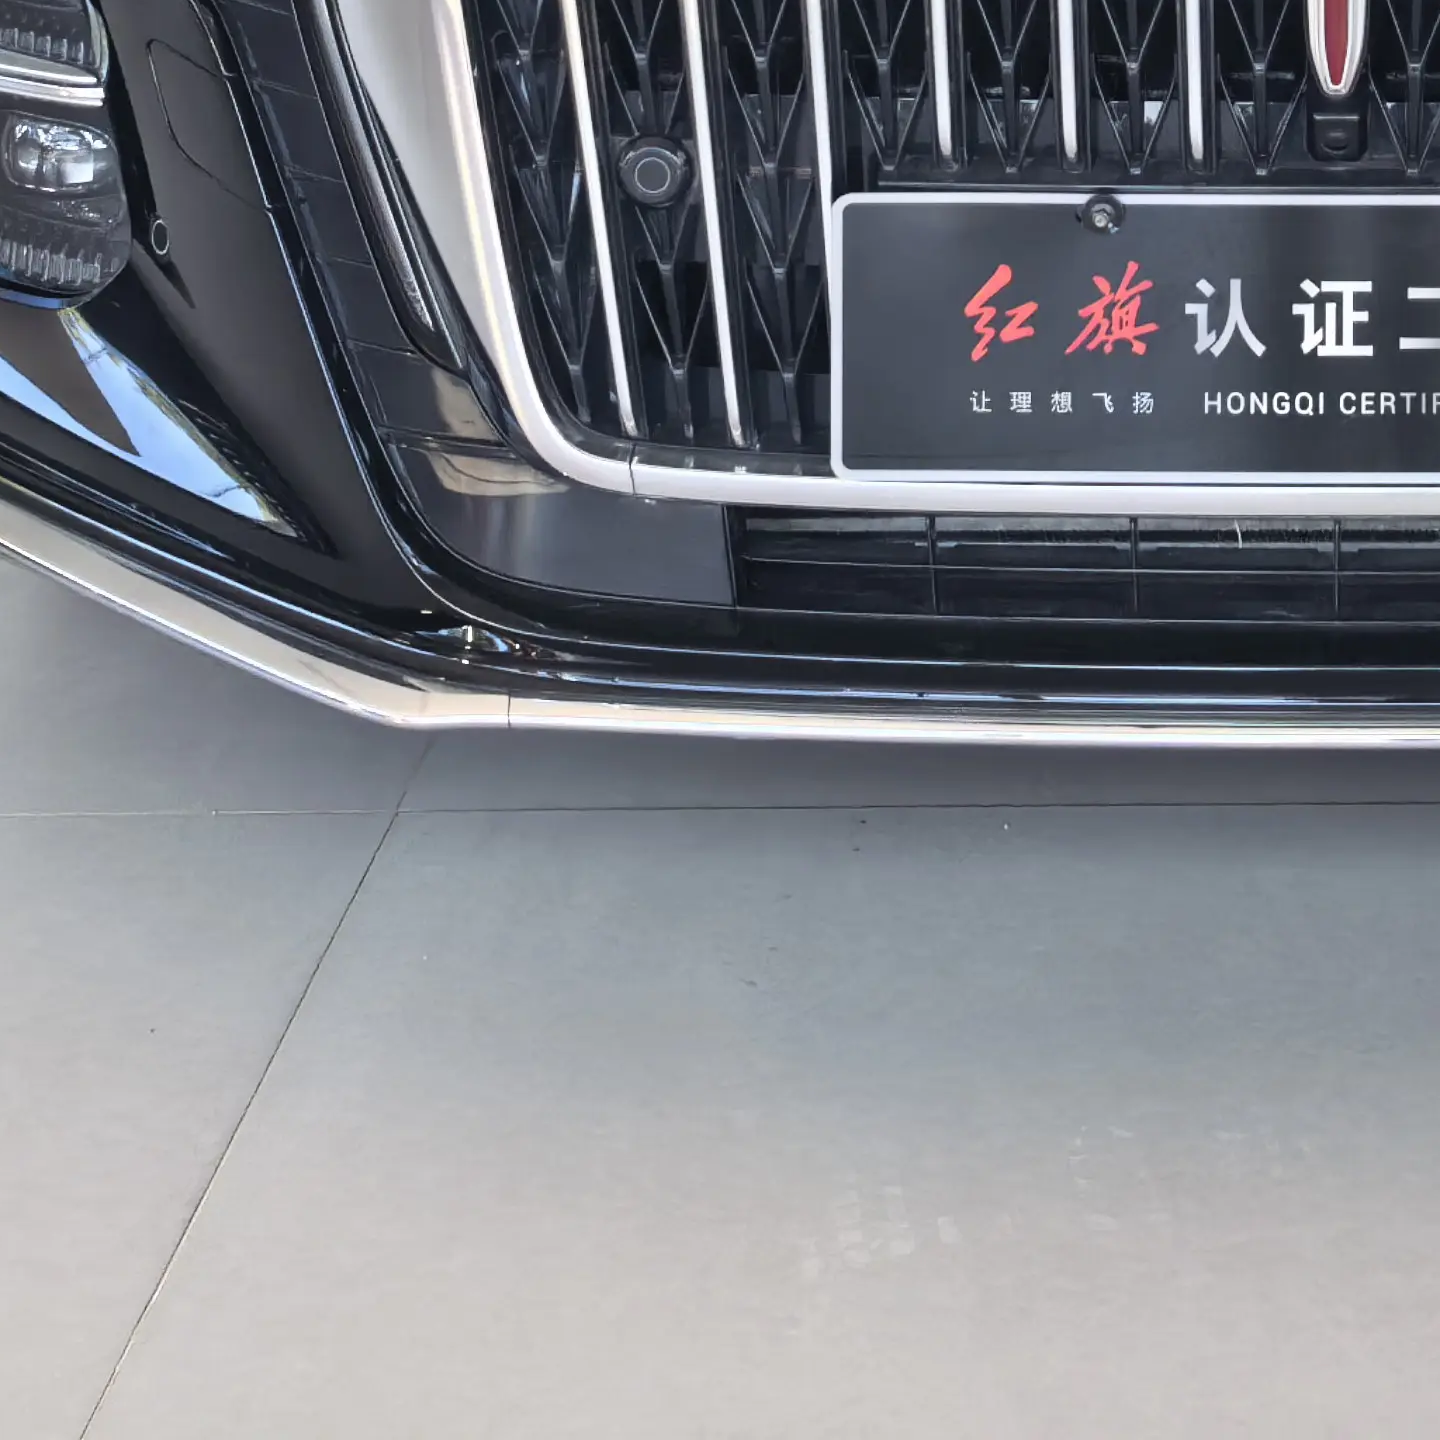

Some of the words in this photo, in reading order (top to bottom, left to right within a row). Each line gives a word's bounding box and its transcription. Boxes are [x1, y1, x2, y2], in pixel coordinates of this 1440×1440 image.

[969, 388, 1155, 416] 让理想飞扬
[1203, 391, 1326, 417] HONGQI
